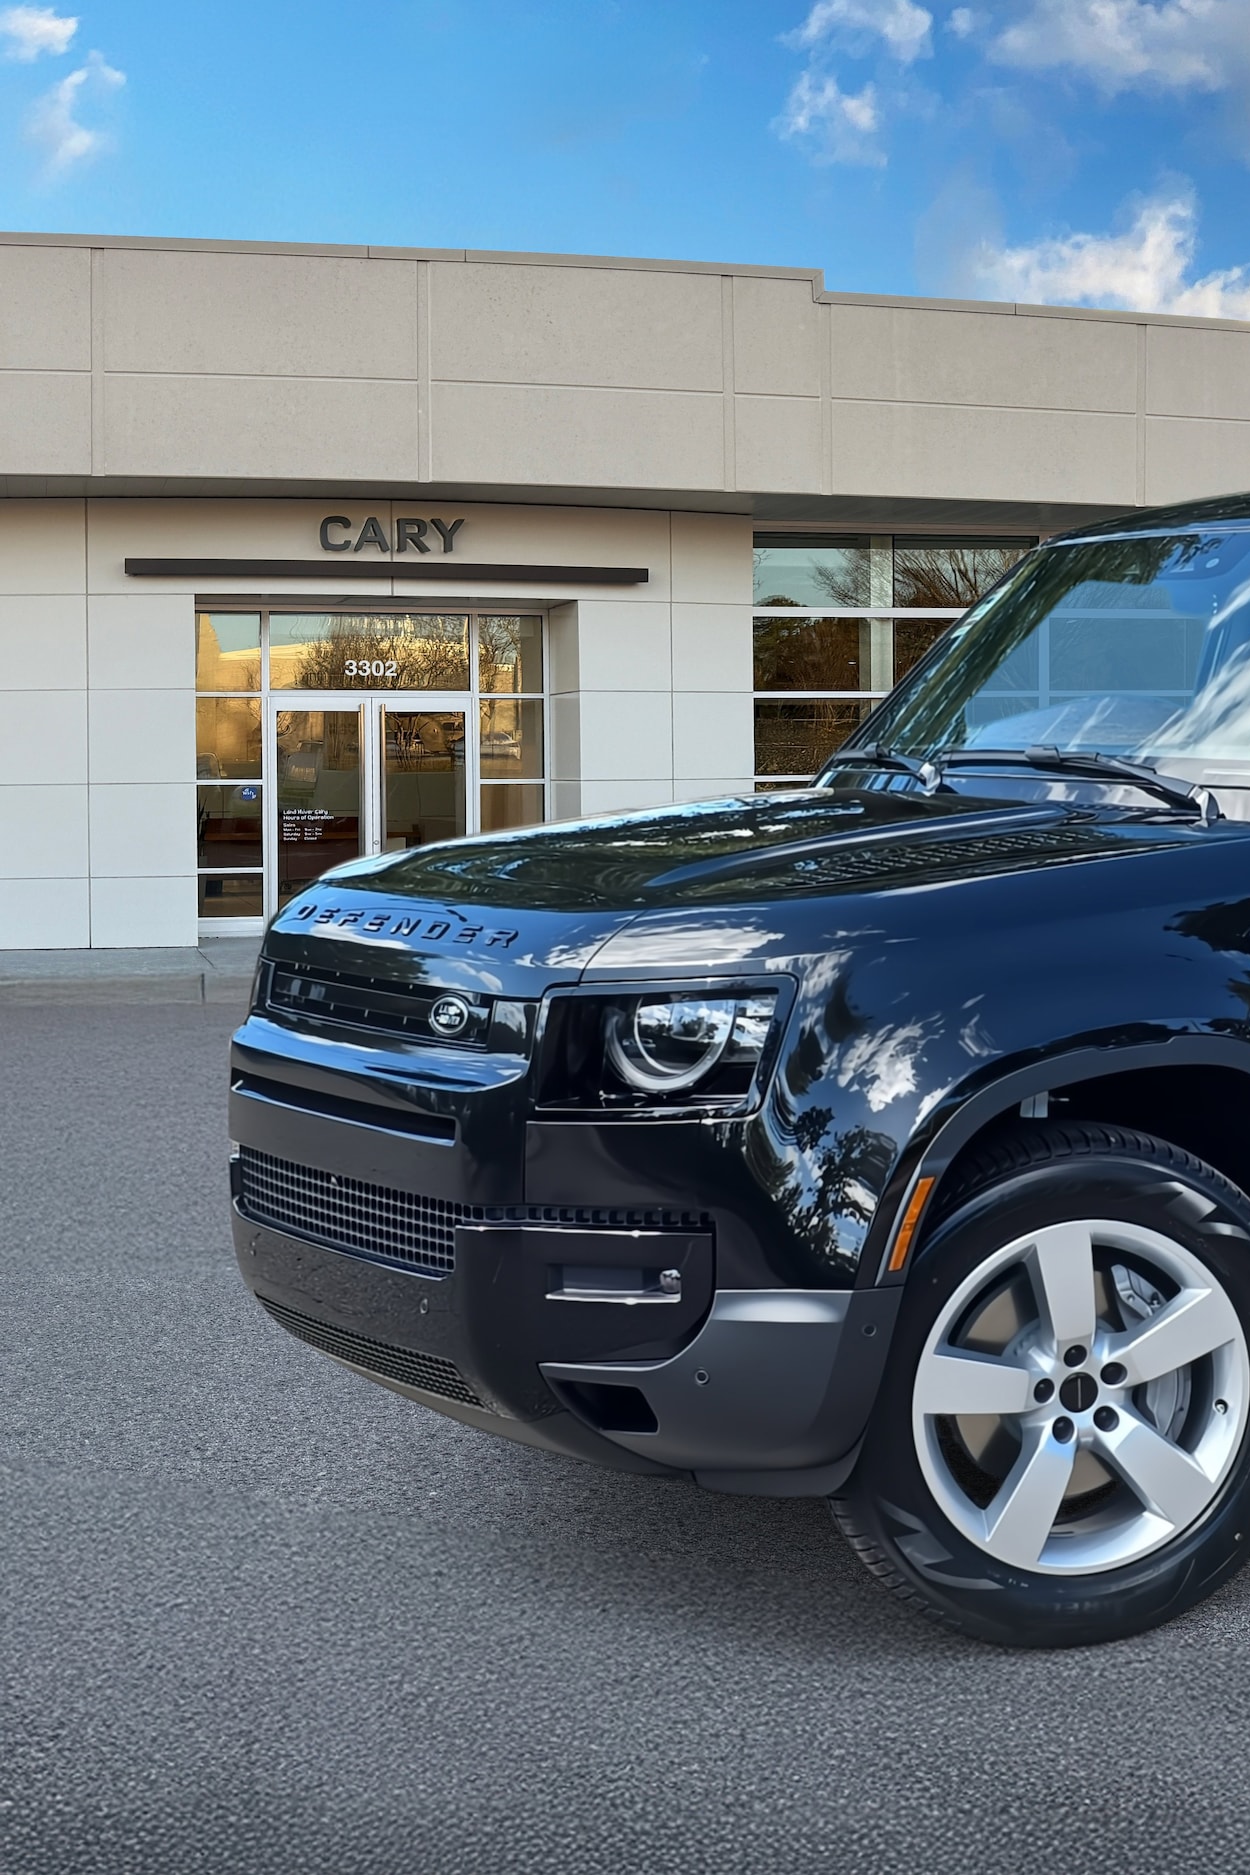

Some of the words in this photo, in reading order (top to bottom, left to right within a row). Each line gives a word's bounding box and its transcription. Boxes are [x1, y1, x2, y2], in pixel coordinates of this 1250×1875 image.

[320, 515, 465, 553] CARY
[344, 660, 398, 676] 3302
[297, 904, 519, 948] DEFENDER
